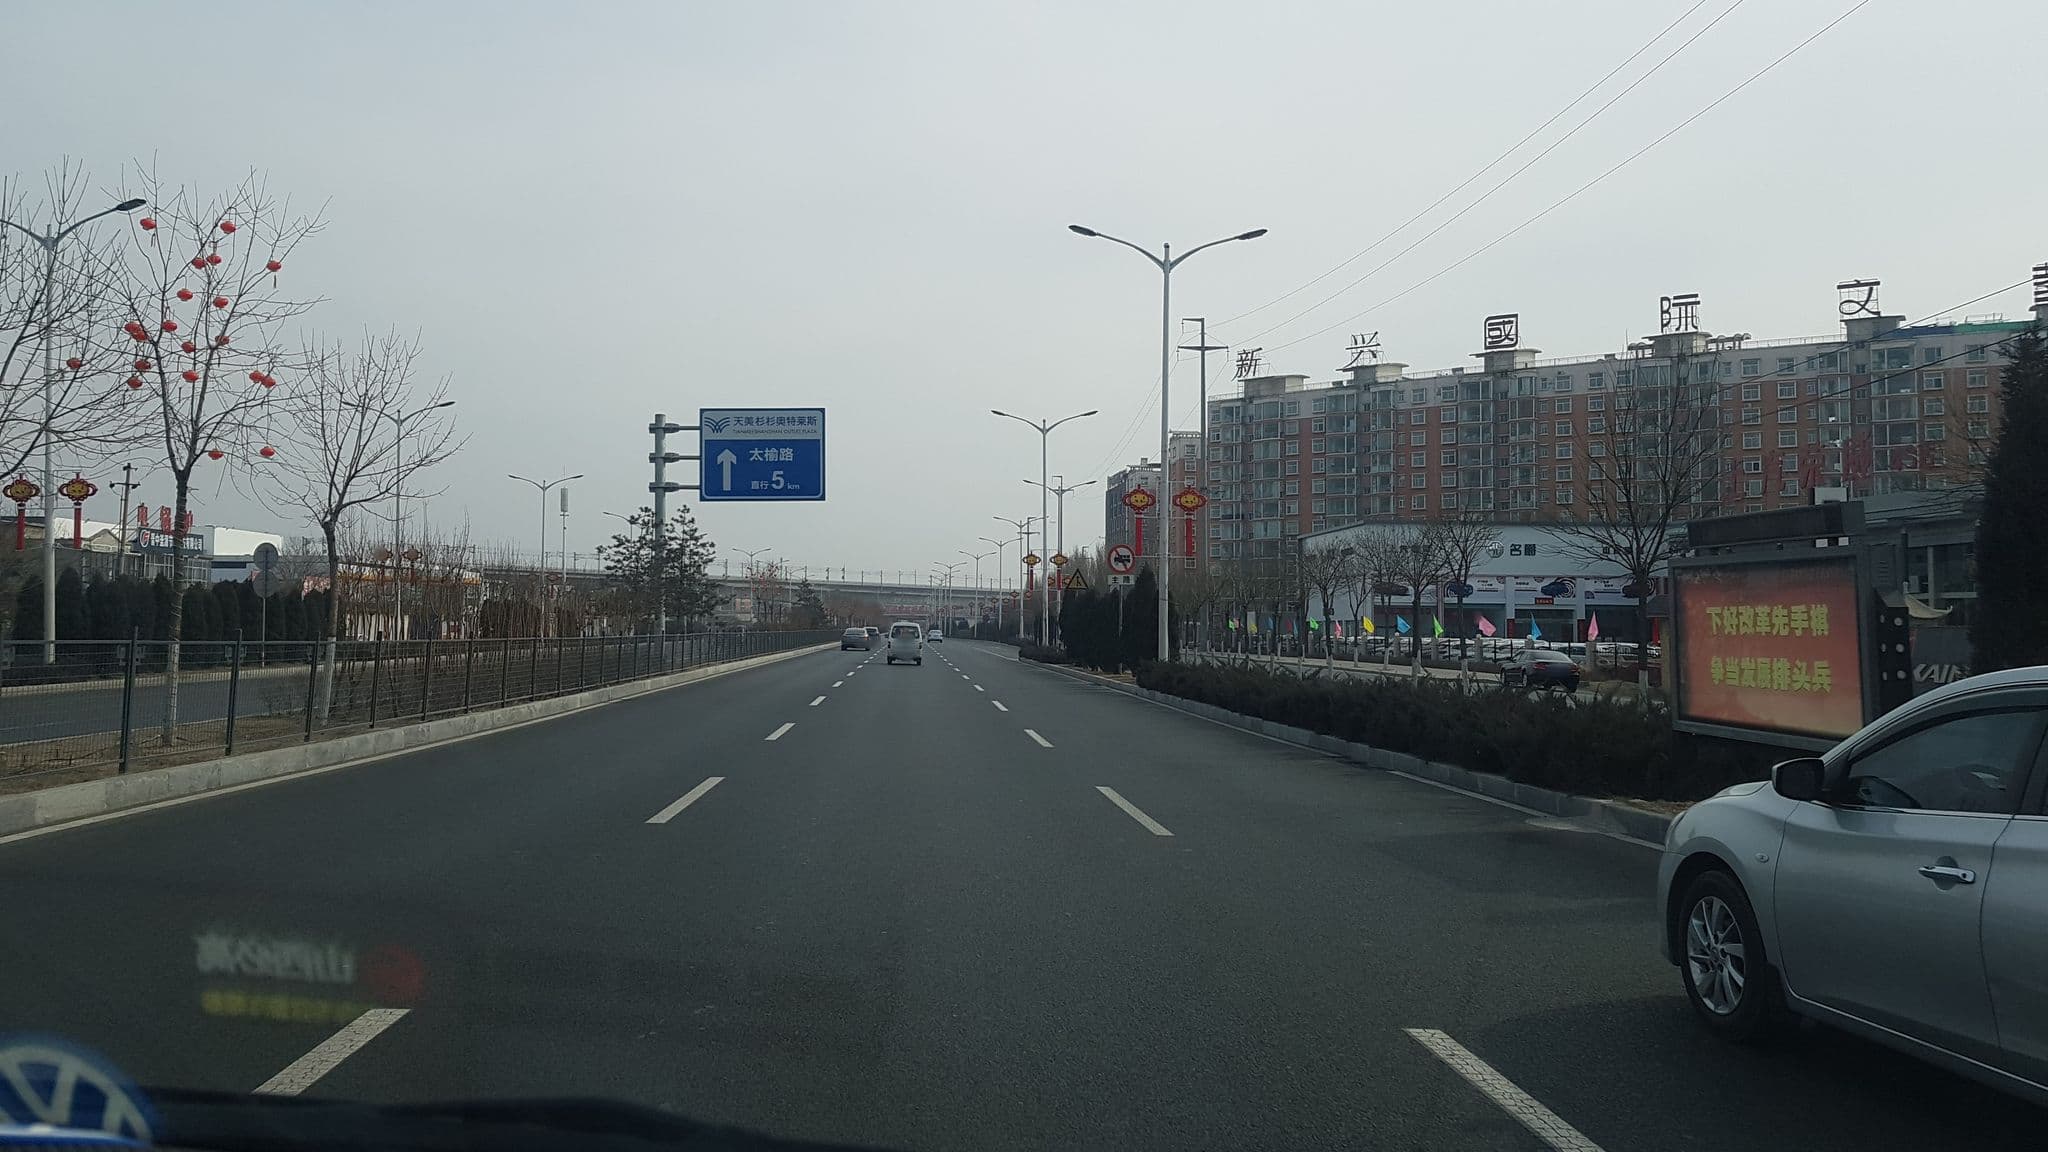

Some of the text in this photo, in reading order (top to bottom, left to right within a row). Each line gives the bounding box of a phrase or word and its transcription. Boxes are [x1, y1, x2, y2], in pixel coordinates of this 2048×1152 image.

[733, 416, 817, 427] 天美杉杉奥特莱斯
[749, 447, 794, 461] 太榆路
[751, 470, 800, 490] 直行 5 km
[1509, 543, 1537, 556] 名爵
[1706, 604, 1830, 637] 下好改革先手棋
[1710, 656, 1833, 693] 争当发展排头兵
